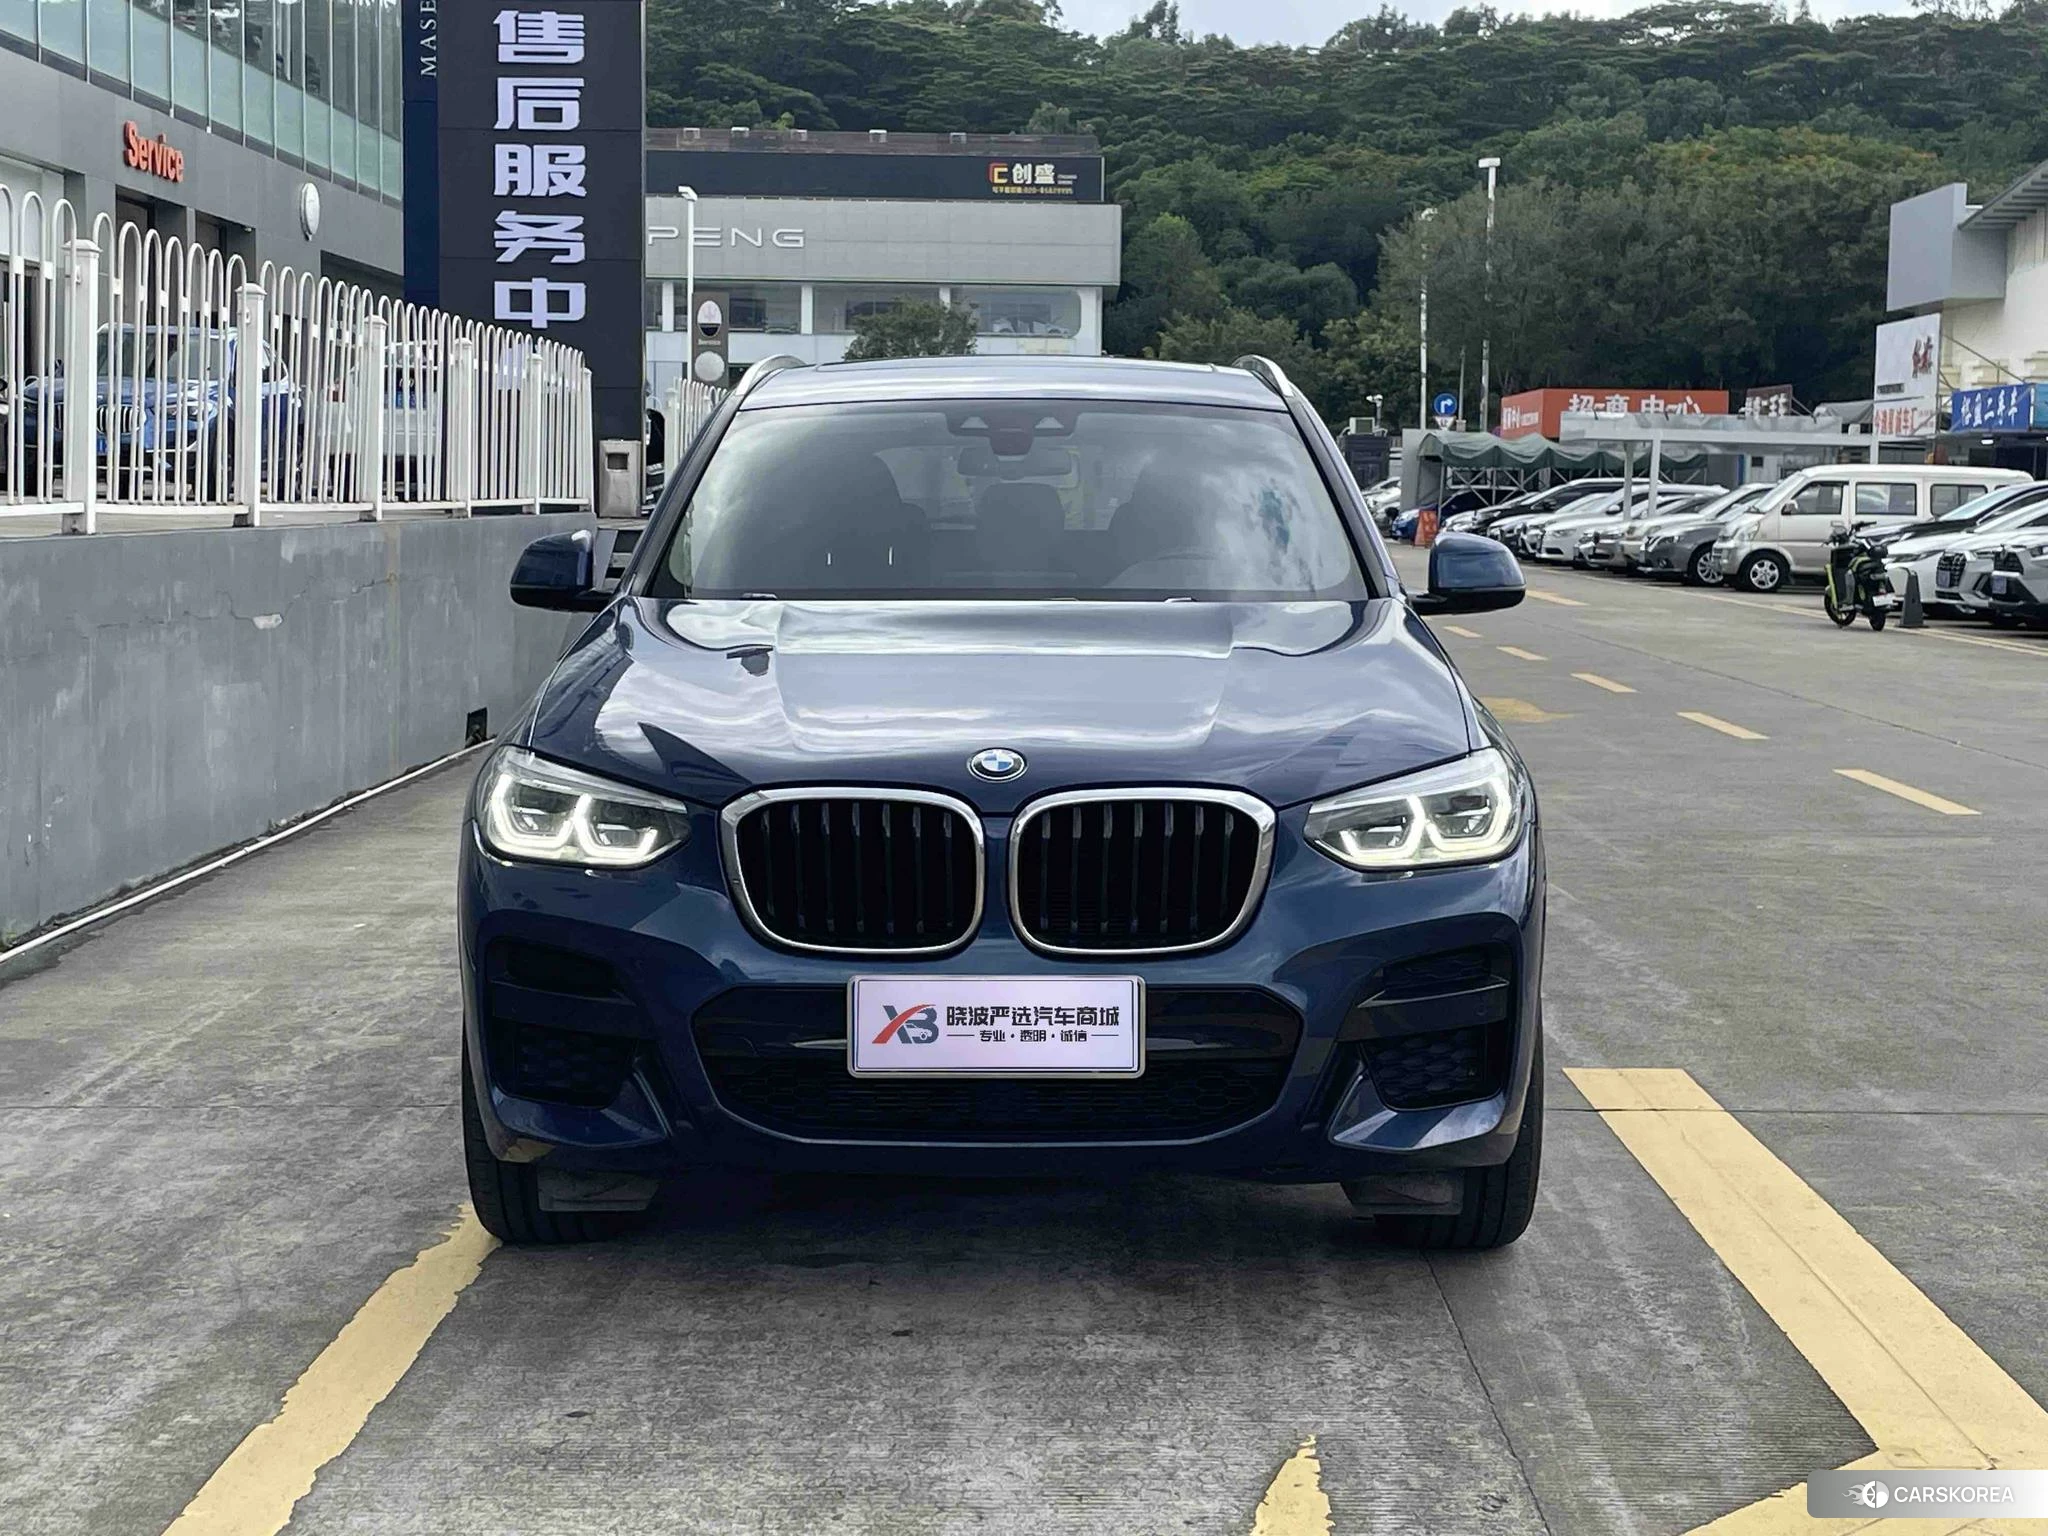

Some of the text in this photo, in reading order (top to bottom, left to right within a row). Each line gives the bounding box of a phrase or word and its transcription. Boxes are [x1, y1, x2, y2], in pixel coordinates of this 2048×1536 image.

[123, 119, 185, 183] Service
[1012, 163, 1055, 185] 创盛
[493, 10, 588, 392] 售后服务中
[647, 226, 805, 248] PENG
[1568, 394, 1705, 417] 招商中心
[946, 1006, 1120, 1027] 晓波严选汽车商城
